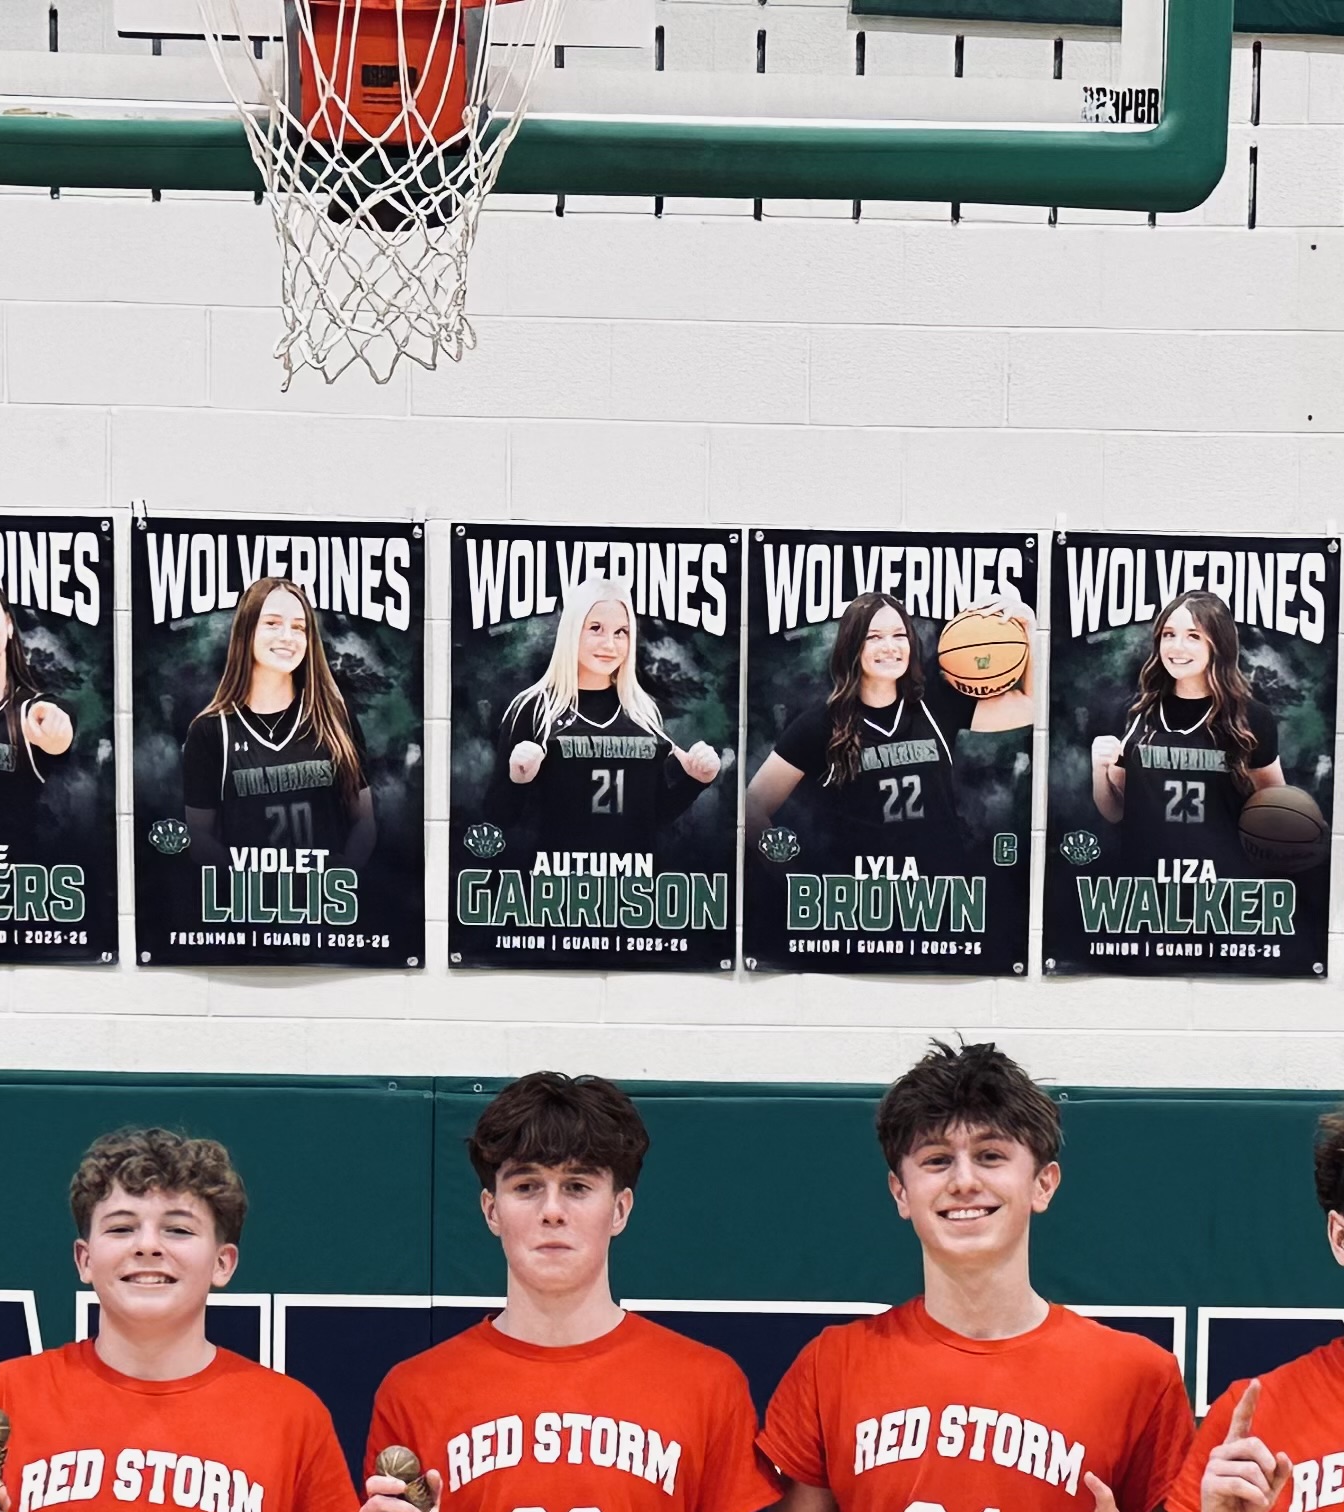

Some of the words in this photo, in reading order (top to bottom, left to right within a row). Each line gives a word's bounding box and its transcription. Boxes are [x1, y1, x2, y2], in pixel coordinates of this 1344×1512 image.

[146, 532, 411, 631] WOLVERINES
[1066, 547, 1326, 645] WOLVERINES
[591, 768, 625, 815] 21
[878, 774, 925, 823] 22
[1164, 780, 1206, 824] 23
[230, 847, 329, 874] VIOLET
[533, 852, 653, 877] AUTUMN
[855, 856, 919, 881] LYLA
[1157, 859, 1217, 884] LIZA
[201, 865, 358, 926] LILLIS
[457, 869, 728, 930] GARRISON
[786, 874, 986, 934] BROWN
[1076, 876, 1296, 935] WALKER
[25, 931, 88, 945] 2025-26
[170, 931, 246, 945] FRESHMAN
[264, 932, 311, 946] GUARD
[328, 933, 390, 948] 2025-26
[495, 935, 545, 949] JUNIOR
[563, 936, 609, 950] GUARD
[627, 938, 688, 951] 2025-26
[789, 939, 840, 954] SENIOR
[858, 940, 904, 955] GUARD
[1090, 943, 1139, 957] JUNIOR
[1156, 943, 1203, 957] GUARD
[1220, 944, 1281, 958] 2025-26
[448, 1415, 523, 1493] RED
[533, 1412, 682, 1496] STORM
[854, 1406, 931, 1475] RED
[937, 1404, 1085, 1497] STORM
